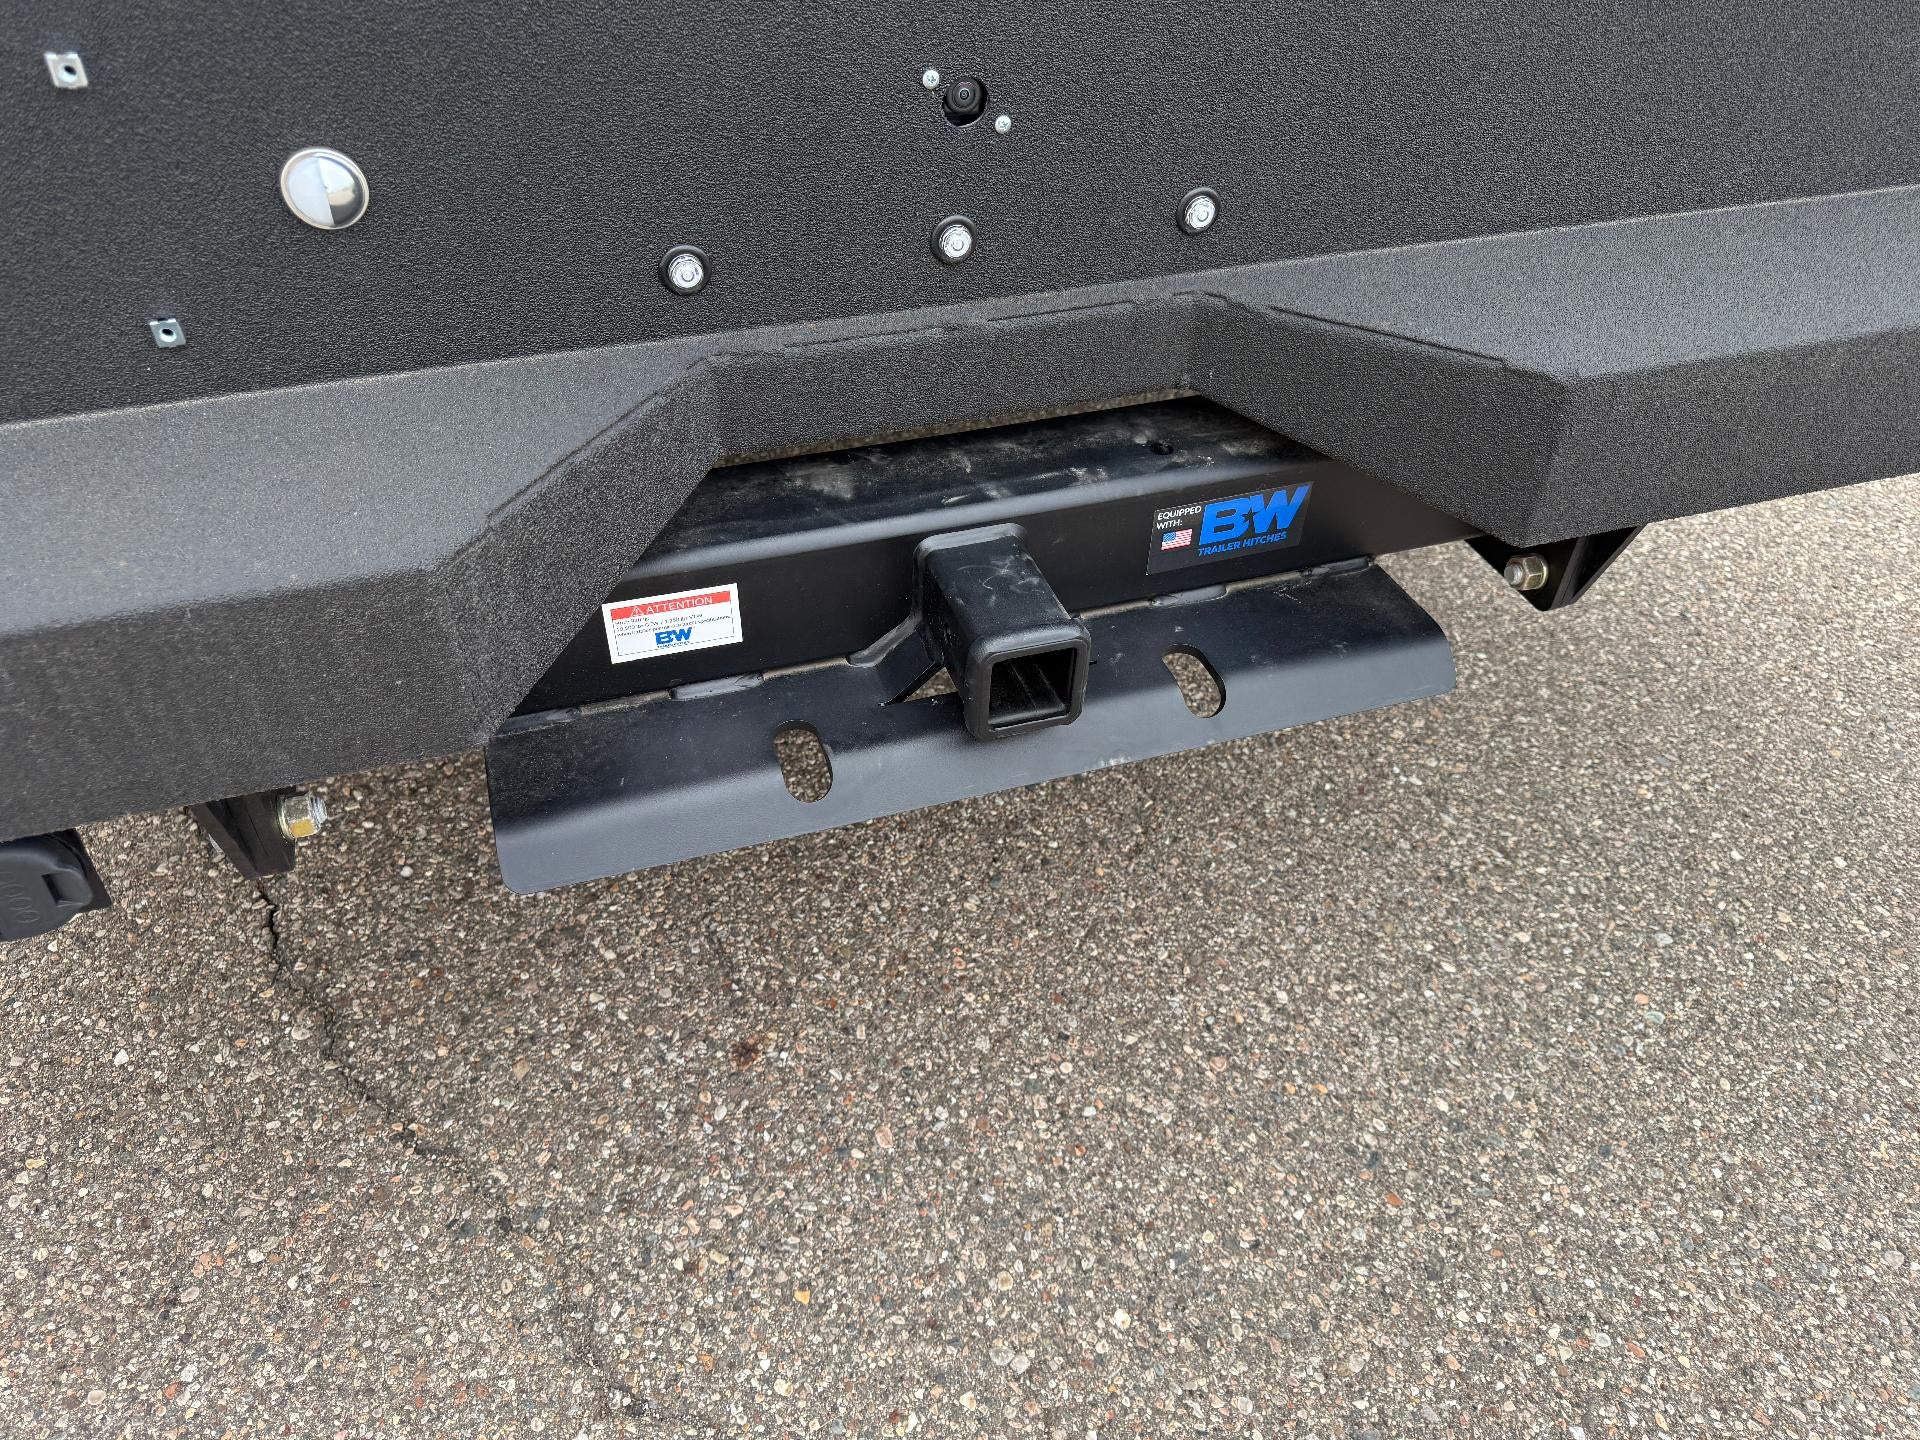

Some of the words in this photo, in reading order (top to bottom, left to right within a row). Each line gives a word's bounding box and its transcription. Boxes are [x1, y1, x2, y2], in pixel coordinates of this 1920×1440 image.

[1157, 505, 1202, 521] EQUIPPED
[1156, 519, 1183, 531] WITH:
[1197, 541, 1241, 557] TRAILER
[1242, 531, 1287, 548] HITCHES
[646, 595, 713, 615] ATTENTION
